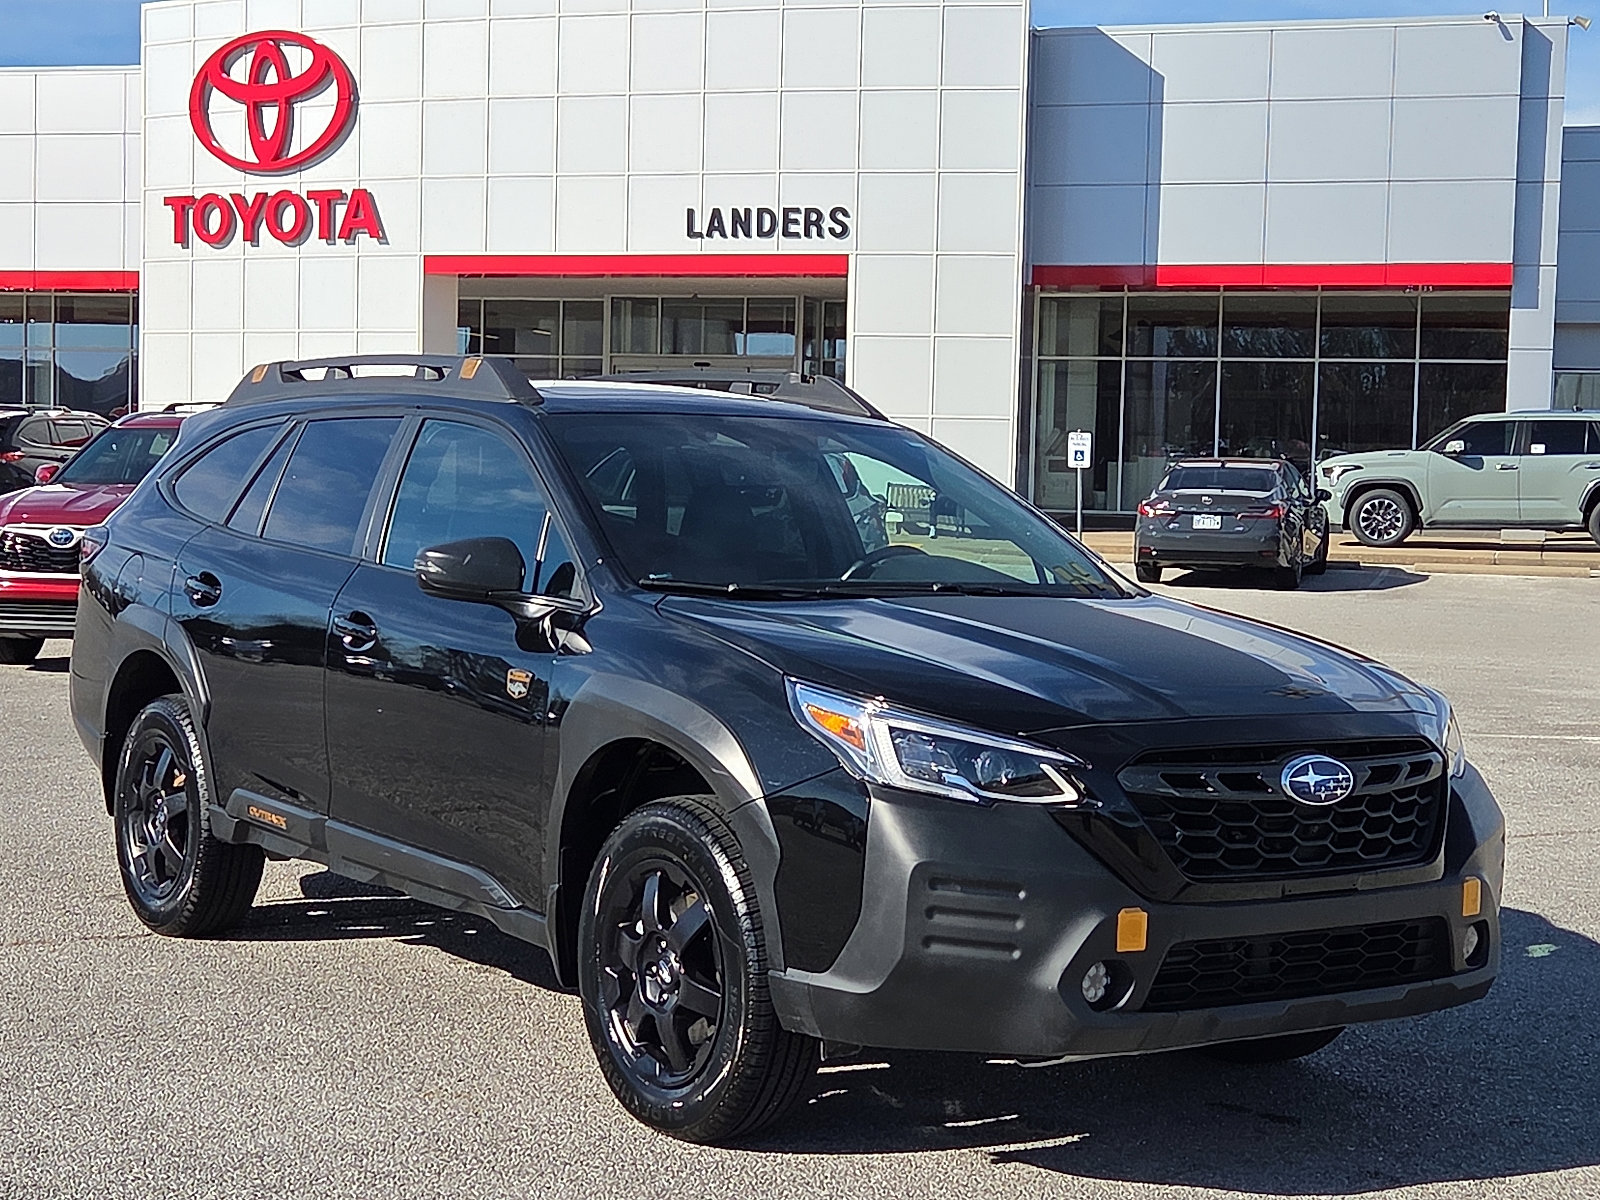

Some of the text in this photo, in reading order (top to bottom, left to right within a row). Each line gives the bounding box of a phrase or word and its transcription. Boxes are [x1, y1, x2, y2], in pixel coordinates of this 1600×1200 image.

[163, 188, 386, 246] TOYOTA
[686, 206, 851, 239] LANDERS
[248, 806, 288, 828] OUTBACK
